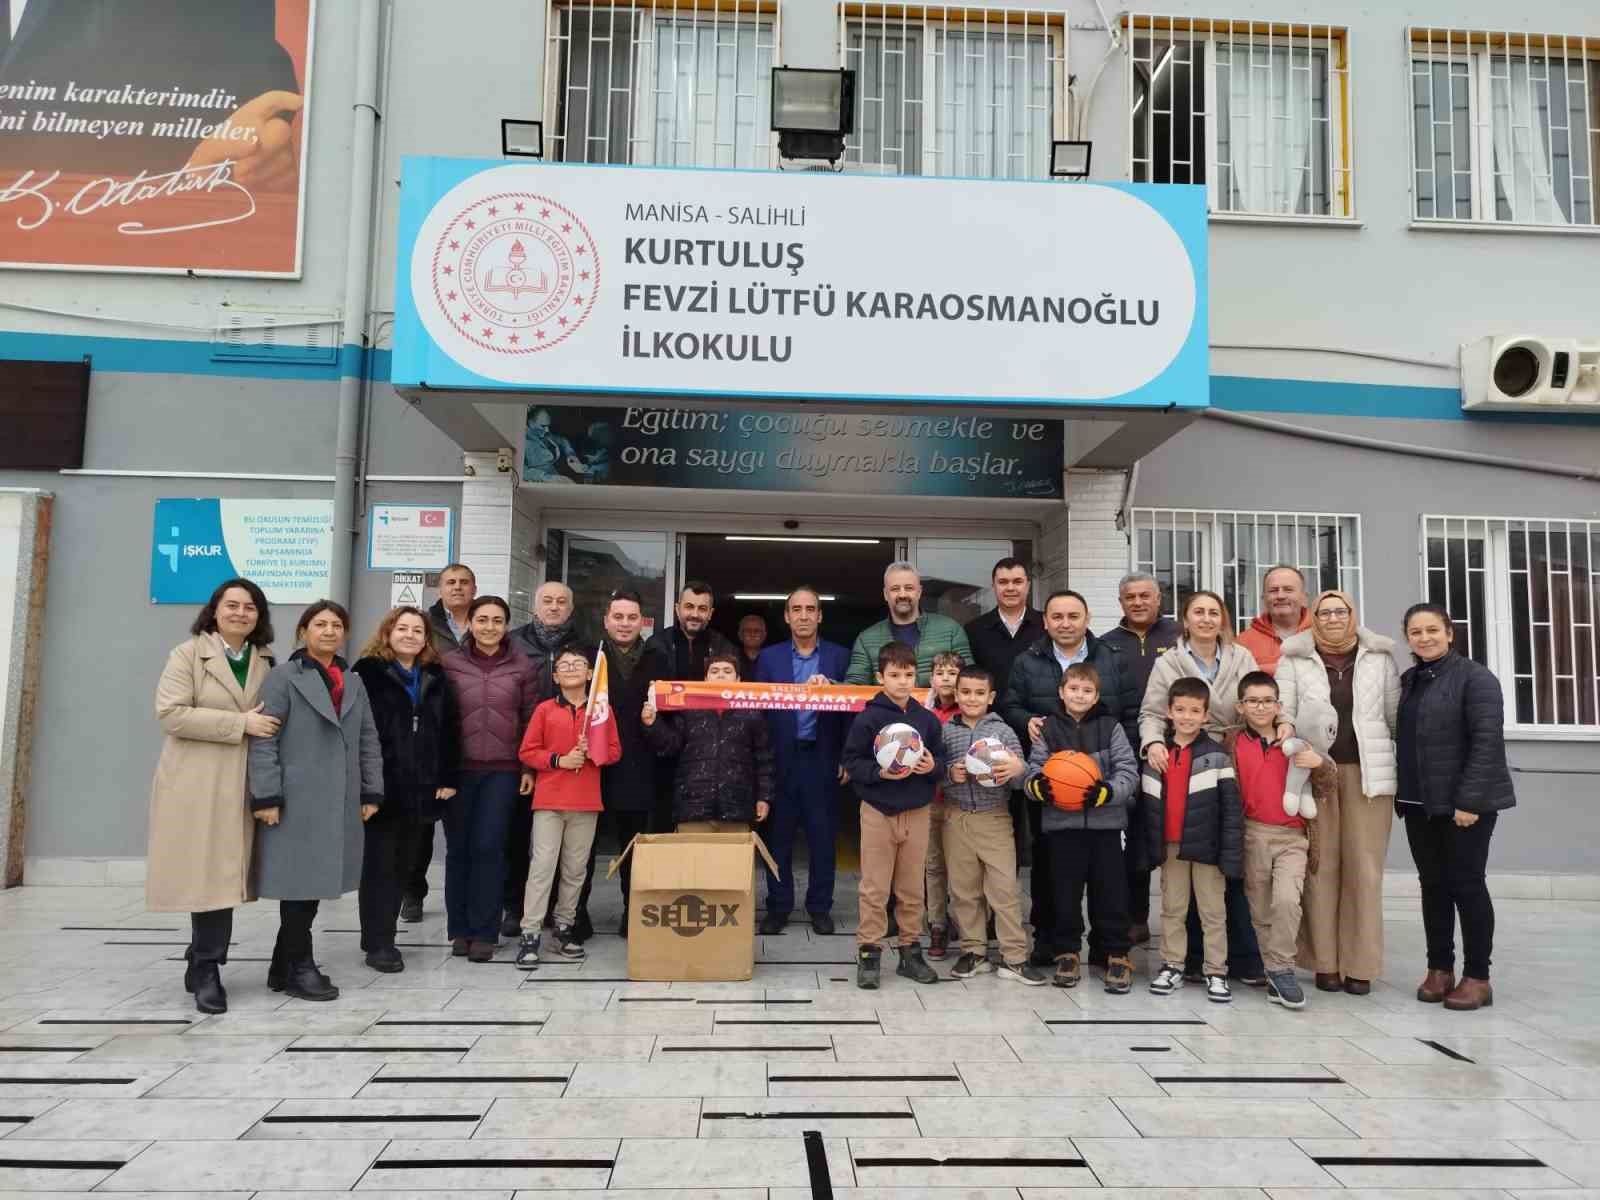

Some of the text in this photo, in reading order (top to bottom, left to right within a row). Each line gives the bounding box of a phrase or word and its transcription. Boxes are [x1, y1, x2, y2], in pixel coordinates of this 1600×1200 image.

[64, 81, 239, 110] karakterimdir.
[32, 111, 144, 139] bilmeyen
[152, 117, 259, 144] milletler,
[624, 202, 709, 224] MANİSA
[728, 205, 807, 226] SALİHLİ
[624, 237, 805, 276] KURTULUŞ
[623, 280, 1160, 326] FEVZİ LÜTFÜ KARAOSMANOĞLU
[622, 324, 793, 363] İLKOKULU
[855, 415, 994, 439] sevmekle
[1011, 421, 1045, 441] ve
[621, 446, 1023, 480] ona saygı duymakla başlar.
[182, 544, 223, 558] İŞKUR
[720, 690, 860, 704] GALATASARAY
[729, 701, 801, 711] TARAFTARLAR
